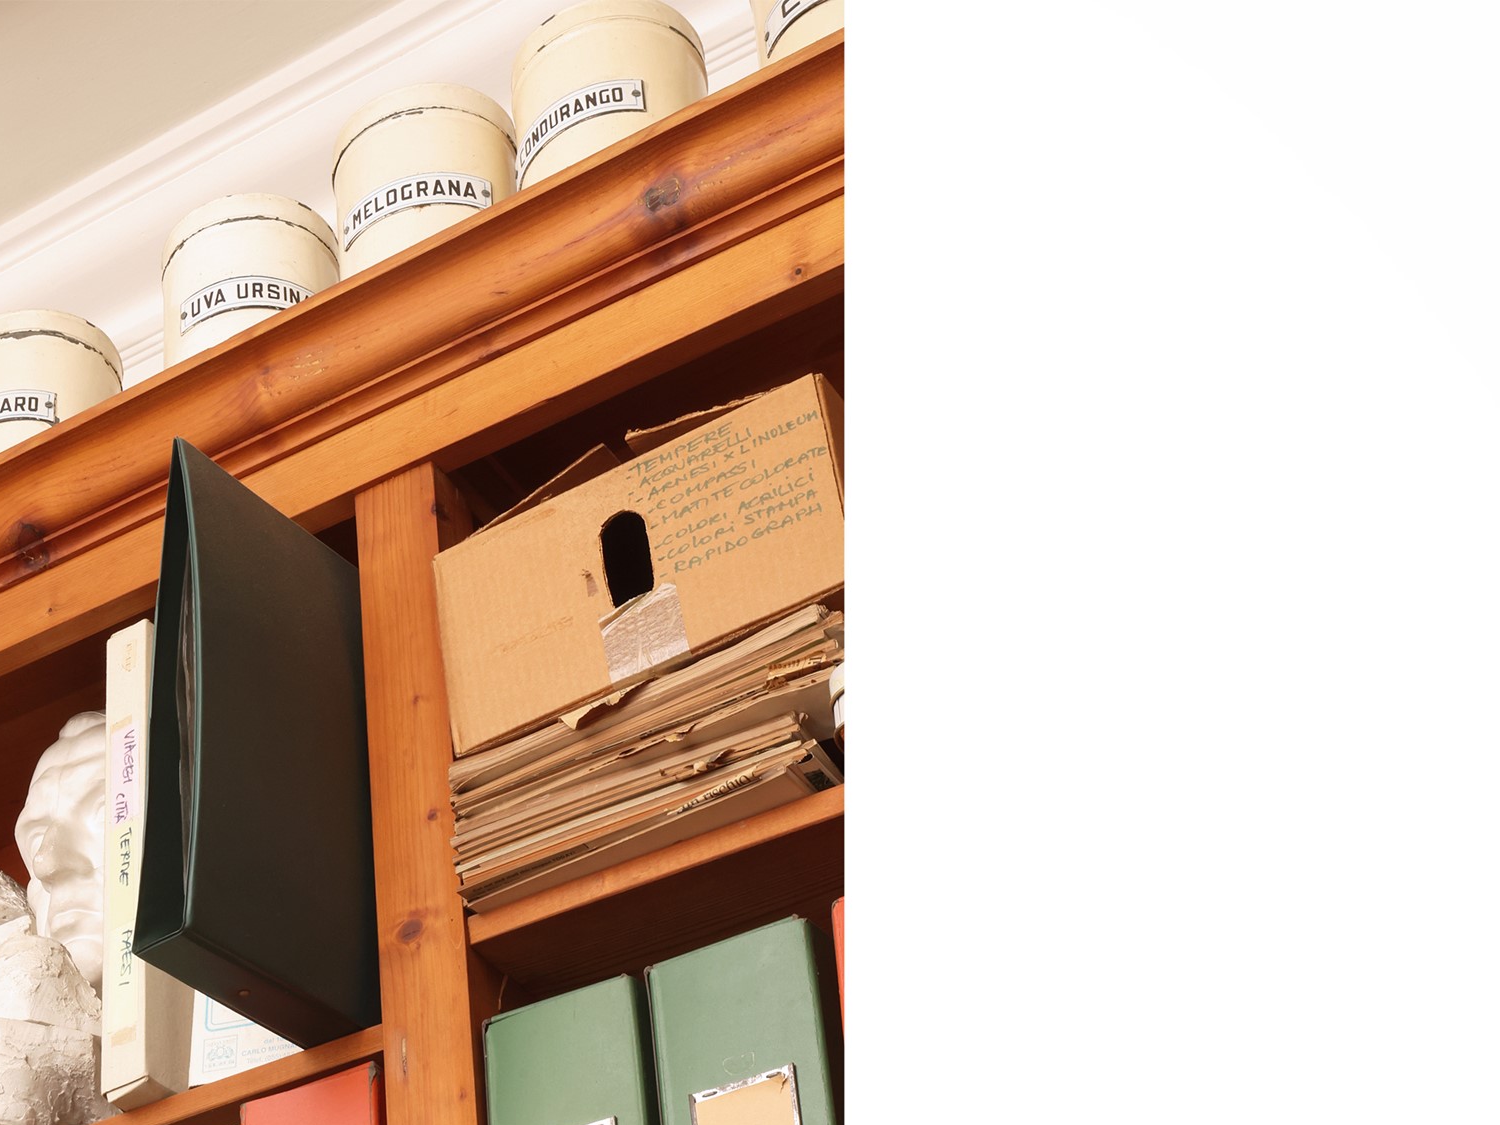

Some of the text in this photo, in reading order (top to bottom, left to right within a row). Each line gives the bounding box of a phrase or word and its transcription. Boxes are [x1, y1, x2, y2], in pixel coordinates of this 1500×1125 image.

[352, 179, 477, 229] MELOGRANA
[191, 282, 311, 318] UVA URSIN
